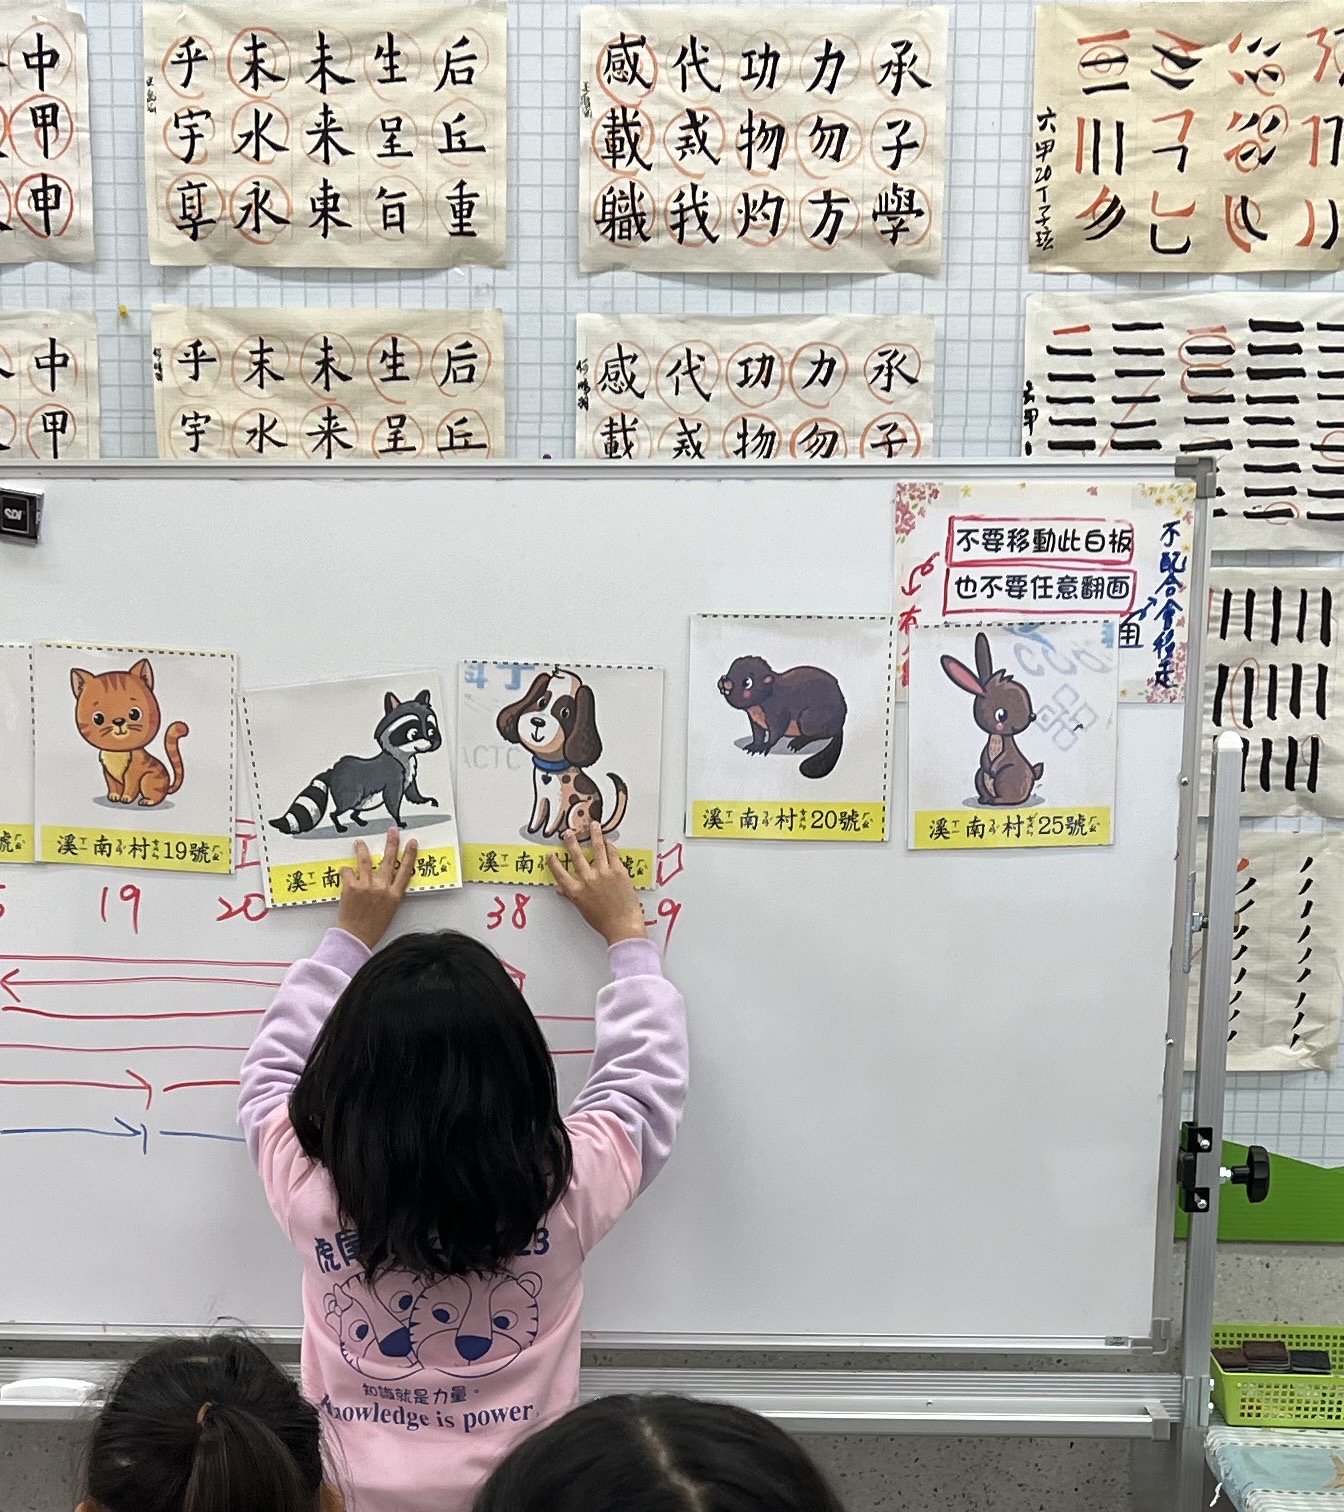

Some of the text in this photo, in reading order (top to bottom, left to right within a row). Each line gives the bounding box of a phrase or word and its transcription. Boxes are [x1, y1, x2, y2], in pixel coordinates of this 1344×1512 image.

[4, 508, 23, 522] SDI
[955, 527, 1134, 554] 不要移動此白板
[954, 574, 1131, 600] 也不要任意翻面
[100, 884, 142, 935] 19
[487, 892, 532, 931] 38
[435, 1410, 455, 1429] is
